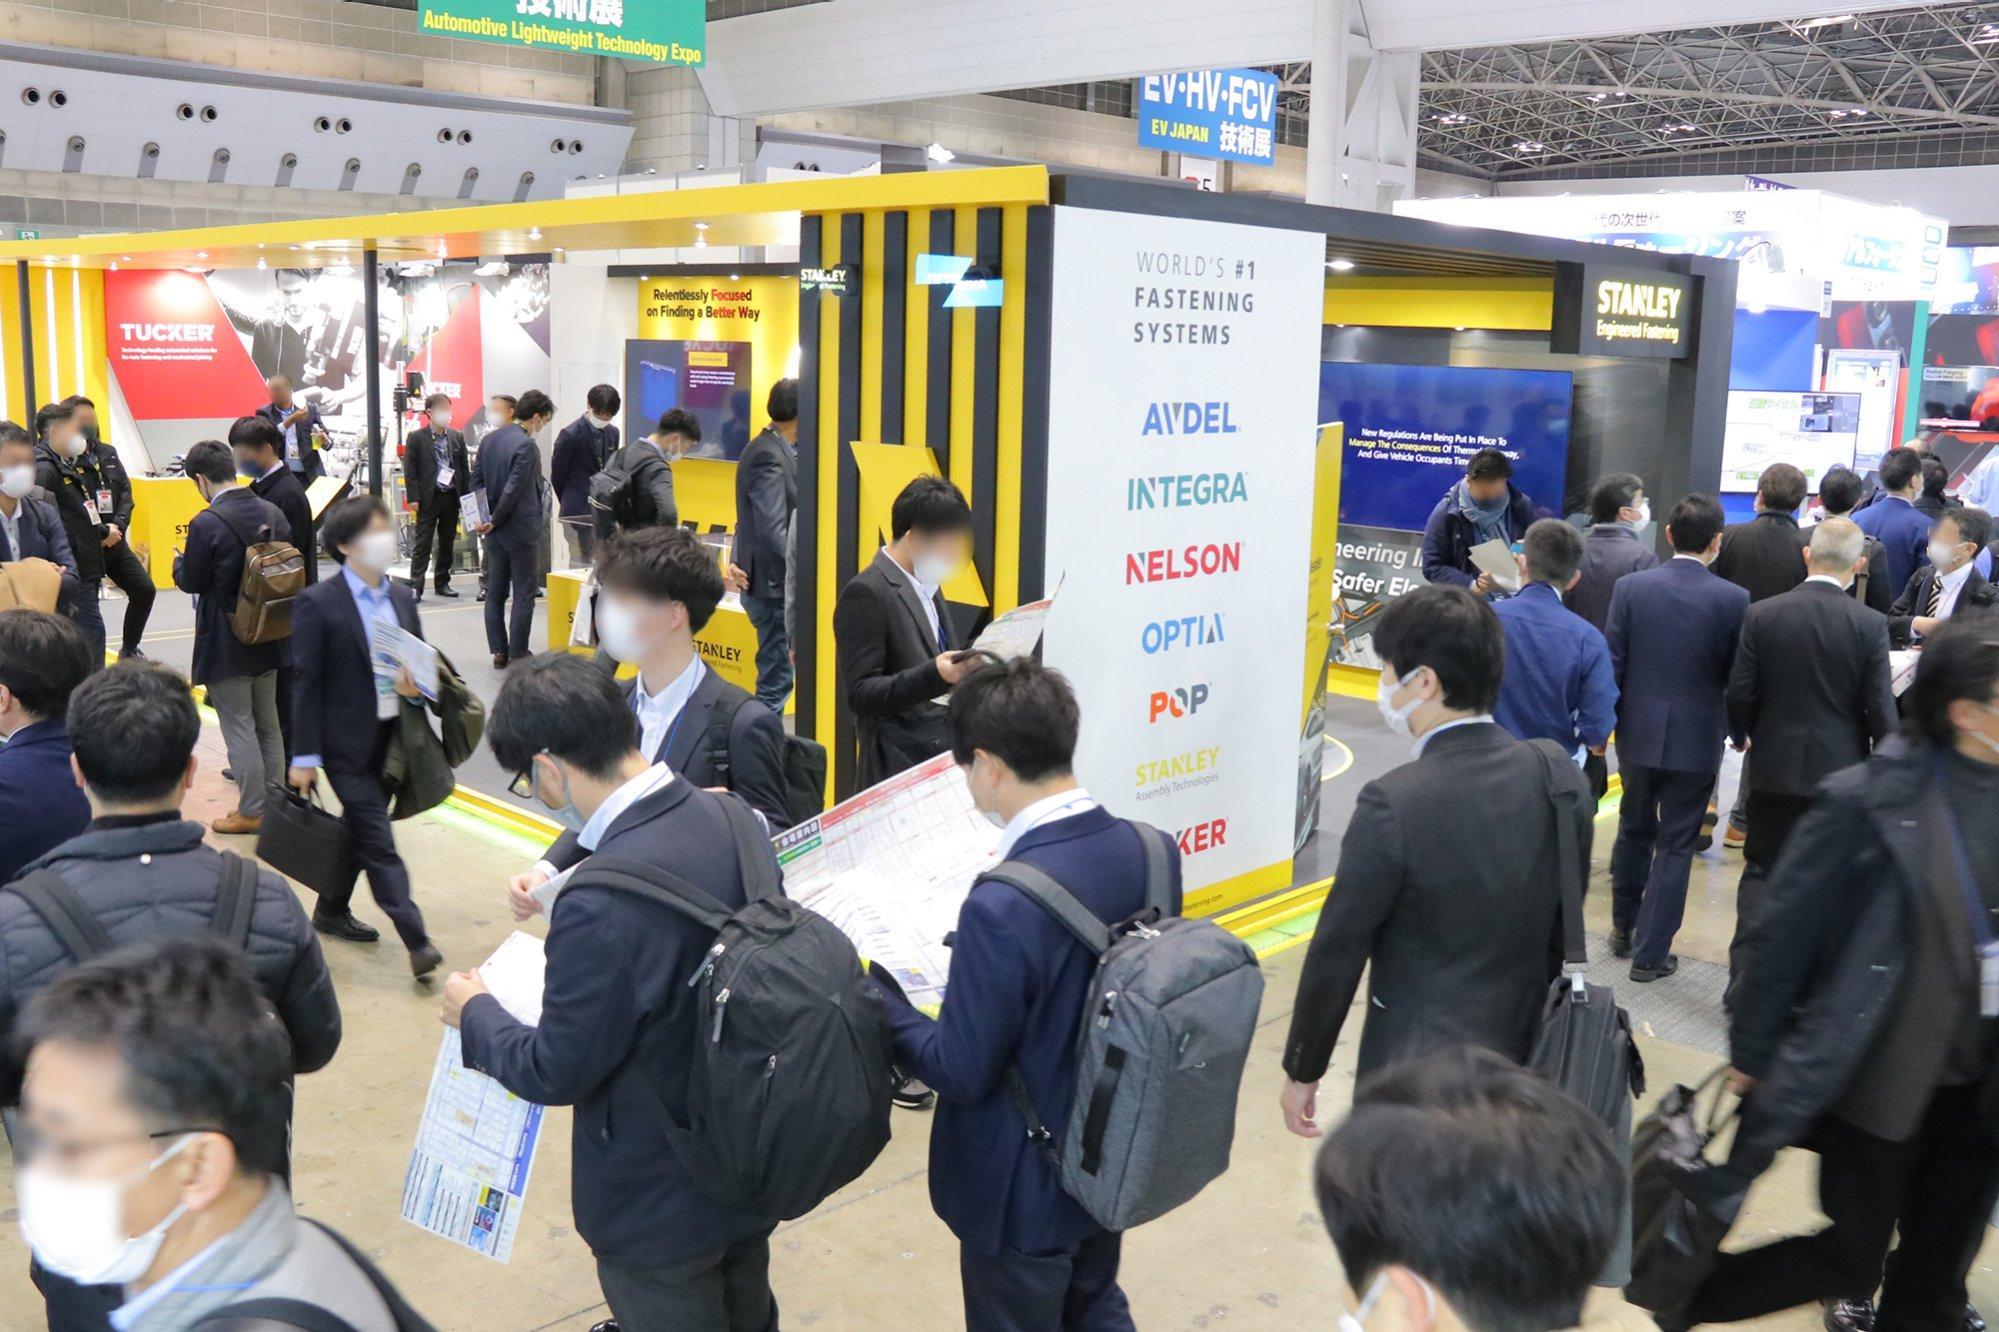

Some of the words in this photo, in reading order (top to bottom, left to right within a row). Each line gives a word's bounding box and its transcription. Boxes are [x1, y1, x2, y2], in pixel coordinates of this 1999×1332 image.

[423, 10, 507, 37] Automotive
[512, 21, 592, 50] Lightweight
[596, 33, 668, 60] Technology
[671, 44, 702, 64] Expo
[1152, 118, 1168, 136] EV
[1170, 123, 1209, 142] JAPAN
[1220, 120, 1272, 158] 技術展
[1137, 252, 1224, 278] WORLD'S
[1236, 260, 1254, 280] #1
[654, 289, 708, 304] Relentlessly
[711, 288, 752, 300] Focused
[1135, 287, 1254, 312] FASTENING
[1598, 280, 1681, 319] STANLEY
[646, 308, 658, 316] on
[660, 306, 694, 320] Finding
[698, 310, 702, 318] a
[706, 306, 735, 318] Better
[738, 306, 760, 322] Way
[120, 324, 215, 342] TUCKER
[1134, 322, 1230, 344] SYSTEMS
[1597, 319, 1642, 340] Engineered
[1643, 322, 1678, 344] Fastening
[1142, 402, 1236, 436] AVDEL
[1349, 438, 1377, 449] Manage
[1378, 440, 1390, 448] The
[1391, 441, 1441, 453] Consequences
[1442, 444, 1453, 454] Of
[1362, 428, 1378, 437] New
[1378, 430, 1418, 440] Regulations
[1420, 432, 1432, 441] Are
[1434, 433, 1453, 444] Being
[1455, 434, 1468, 444] Put
[1468, 436, 1476, 444] In
[1477, 436, 1496, 446] Place
[1498, 438, 1506, 446] To
[1358, 450, 1372, 458] And
[1374, 450, 1388, 460] Give
[1390, 452, 1414, 461] Vehicle
[1416, 454, 1452, 466] Occupants
[1128, 472, 1248, 510] INTEGRA
[1126, 542, 1240, 585] NELSON
[1336, 542, 1407, 570] neering
[1333, 569, 1384, 594] Safer
[1141, 612, 1224, 654] OPTIA
[1150, 684, 1208, 724] POP
[1136, 746, 1220, 787] STANLEY
[1136, 784, 1171, 802] Assembly
[1172, 772, 1220, 792] Technologies
[1176, 818, 1226, 856] KER
